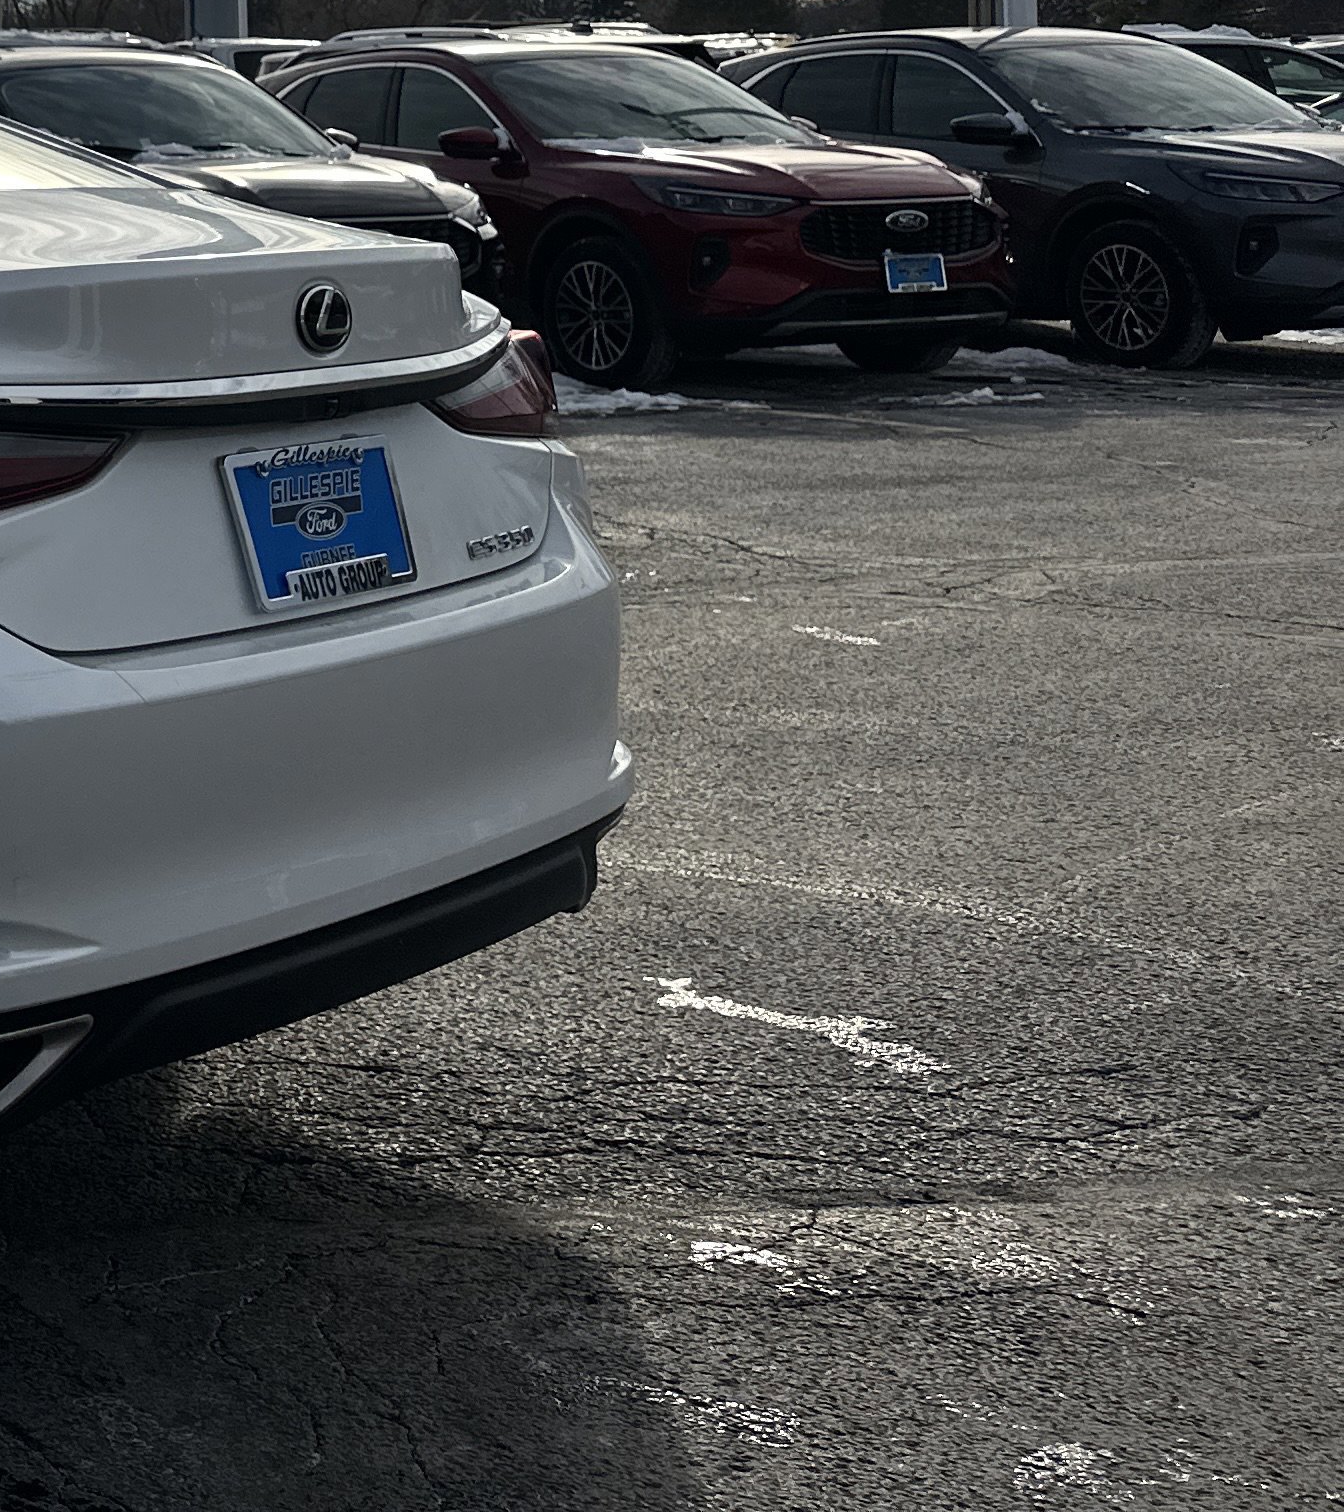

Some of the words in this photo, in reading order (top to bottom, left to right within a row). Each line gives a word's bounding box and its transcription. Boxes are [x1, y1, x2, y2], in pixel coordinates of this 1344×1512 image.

[271, 444, 352, 468] Gillespie
[270, 468, 361, 505] GILLESPIE
[306, 508, 338, 533] Ford
[466, 535, 496, 560] ES
[495, 525, 534, 553] 350
[298, 568, 337, 601] AUTO
[337, 559, 383, 594] GROUP
